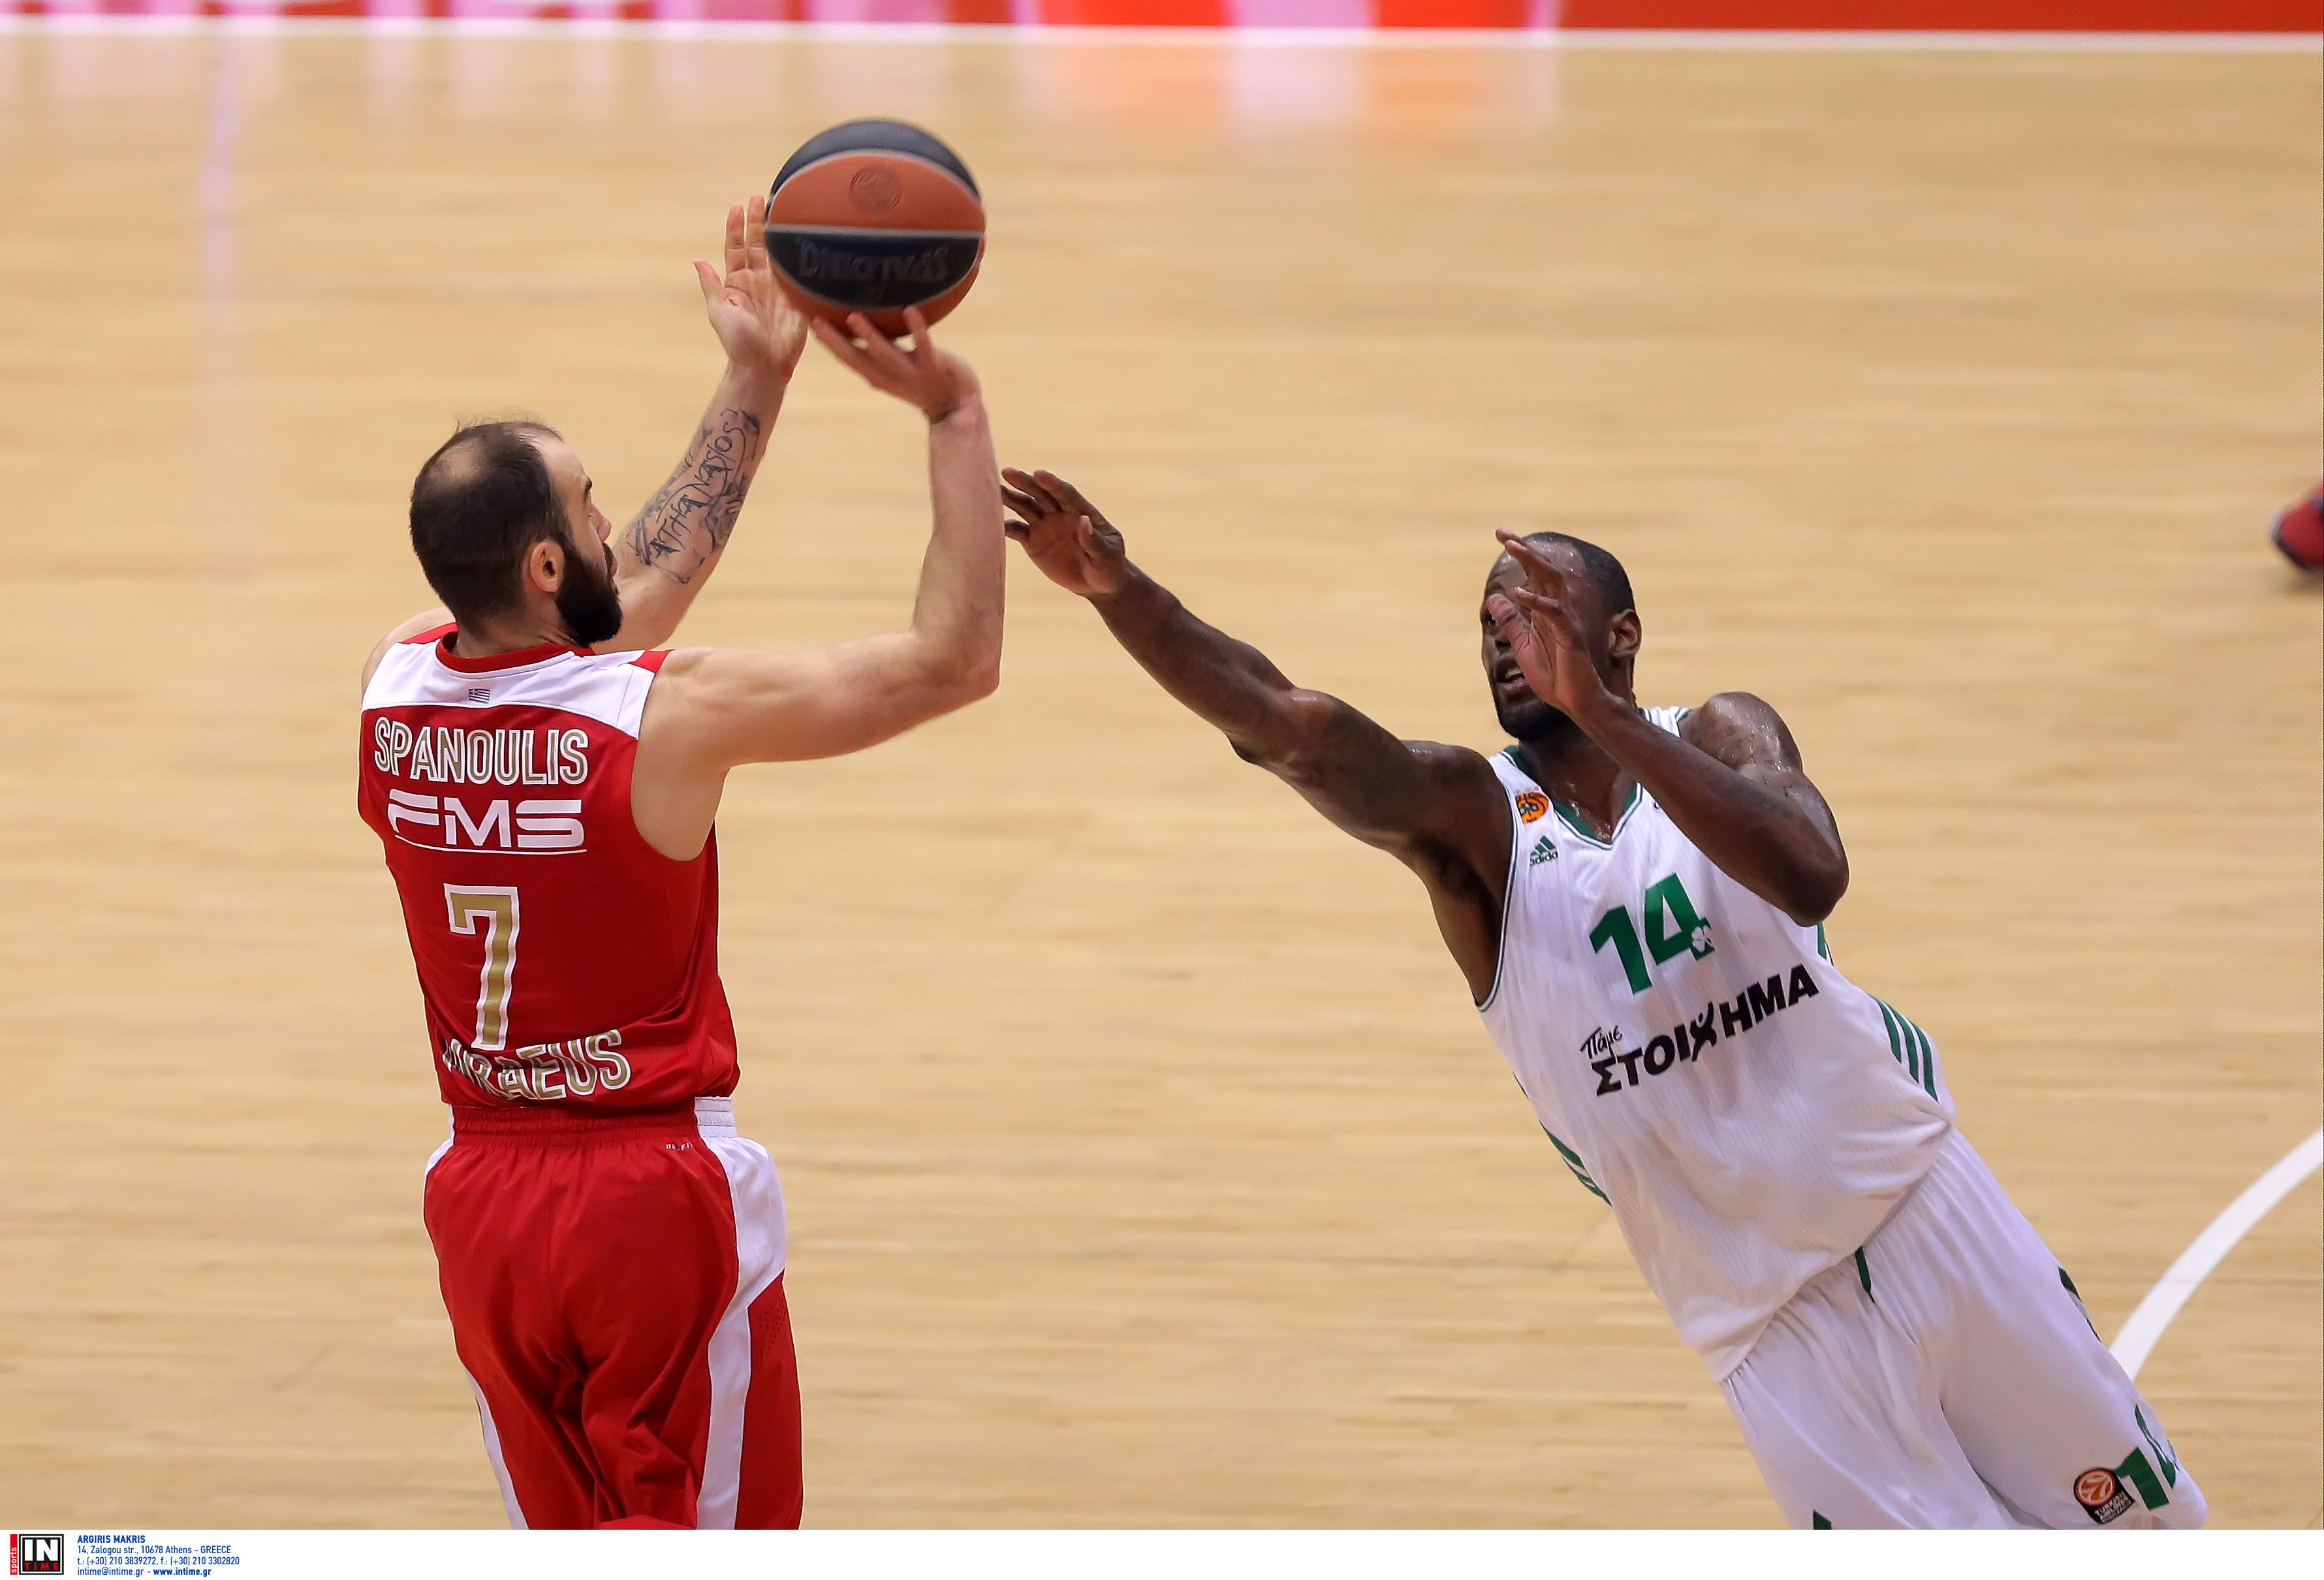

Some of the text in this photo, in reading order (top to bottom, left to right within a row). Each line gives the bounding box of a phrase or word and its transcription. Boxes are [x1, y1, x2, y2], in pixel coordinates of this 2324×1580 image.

[374, 716, 588, 785] SPANOULIS
[1530, 849, 1558, 866] adida
[443, 883, 519, 1051] 7
[1589, 873, 1716, 996] 14
